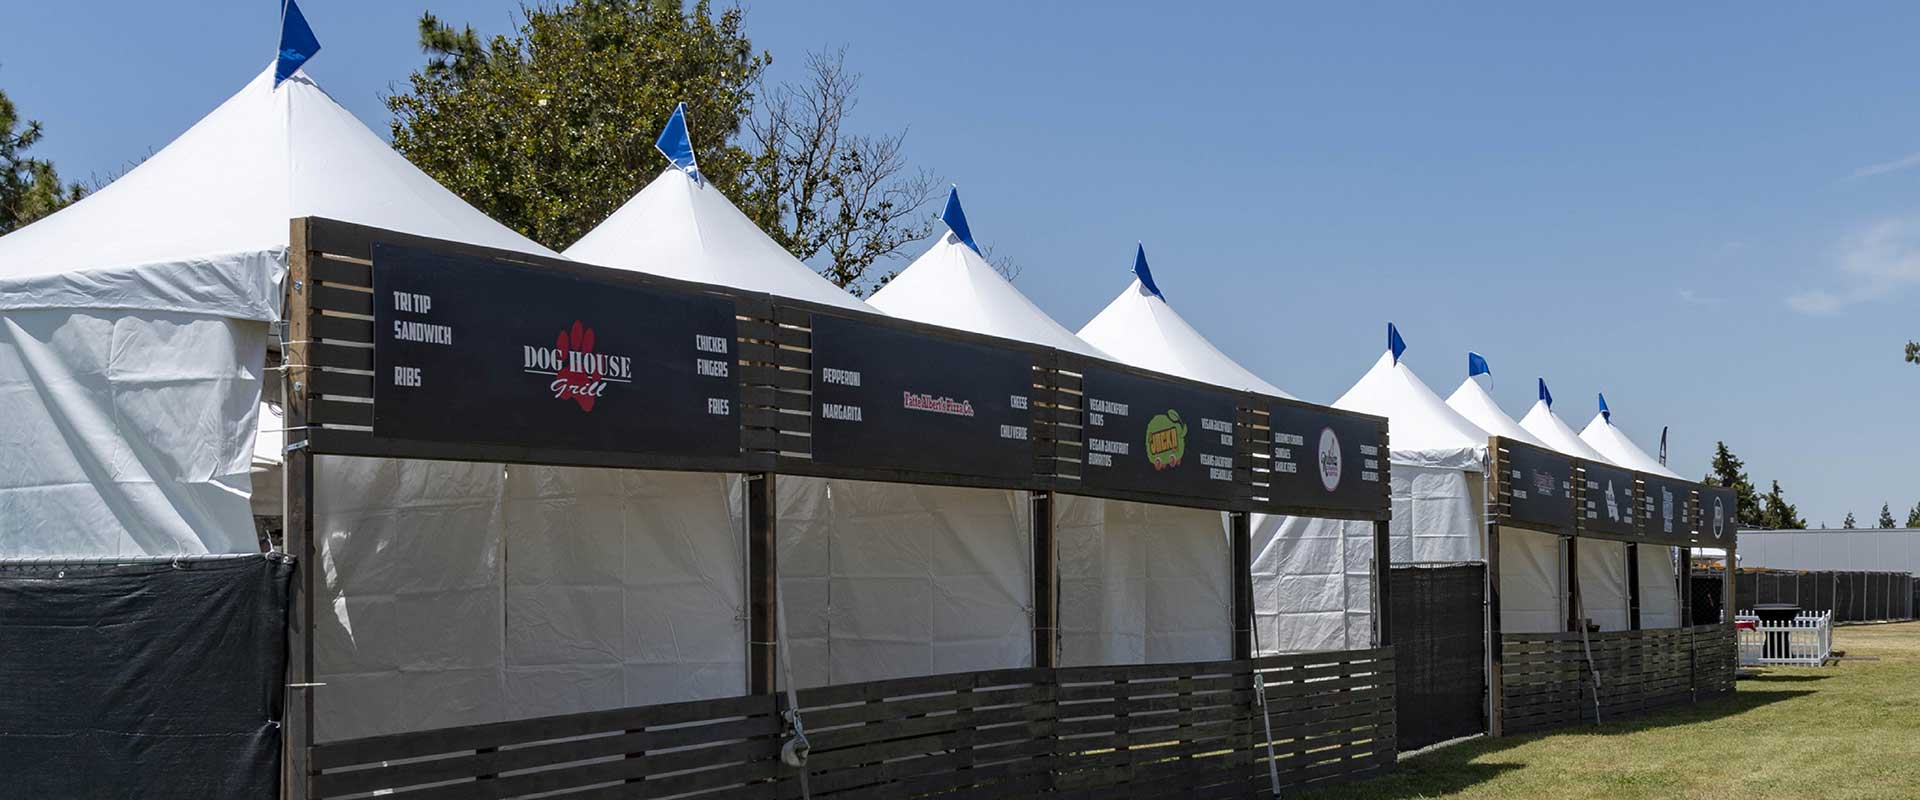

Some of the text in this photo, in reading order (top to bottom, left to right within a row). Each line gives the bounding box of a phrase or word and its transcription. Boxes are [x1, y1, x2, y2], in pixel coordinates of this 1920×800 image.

[393, 291, 431, 314] TRI TIP
[393, 320, 452, 345] SANDWICH
[696, 334, 728, 354] CHICKEN
[524, 345, 632, 379] DOG HOUSE
[697, 358, 728, 378] FINGERS
[394, 366, 421, 387] RIBS
[823, 367, 861, 387] PEPPERONI
[550, 378, 608, 398] Grill
[708, 398, 729, 416] FRIES
[822, 403, 862, 422] MARGARITA
[1010, 395, 1028, 410] CHEESE
[1089, 398, 1105, 412] VEGAN
[1088, 438, 1105, 452] VEGAN
